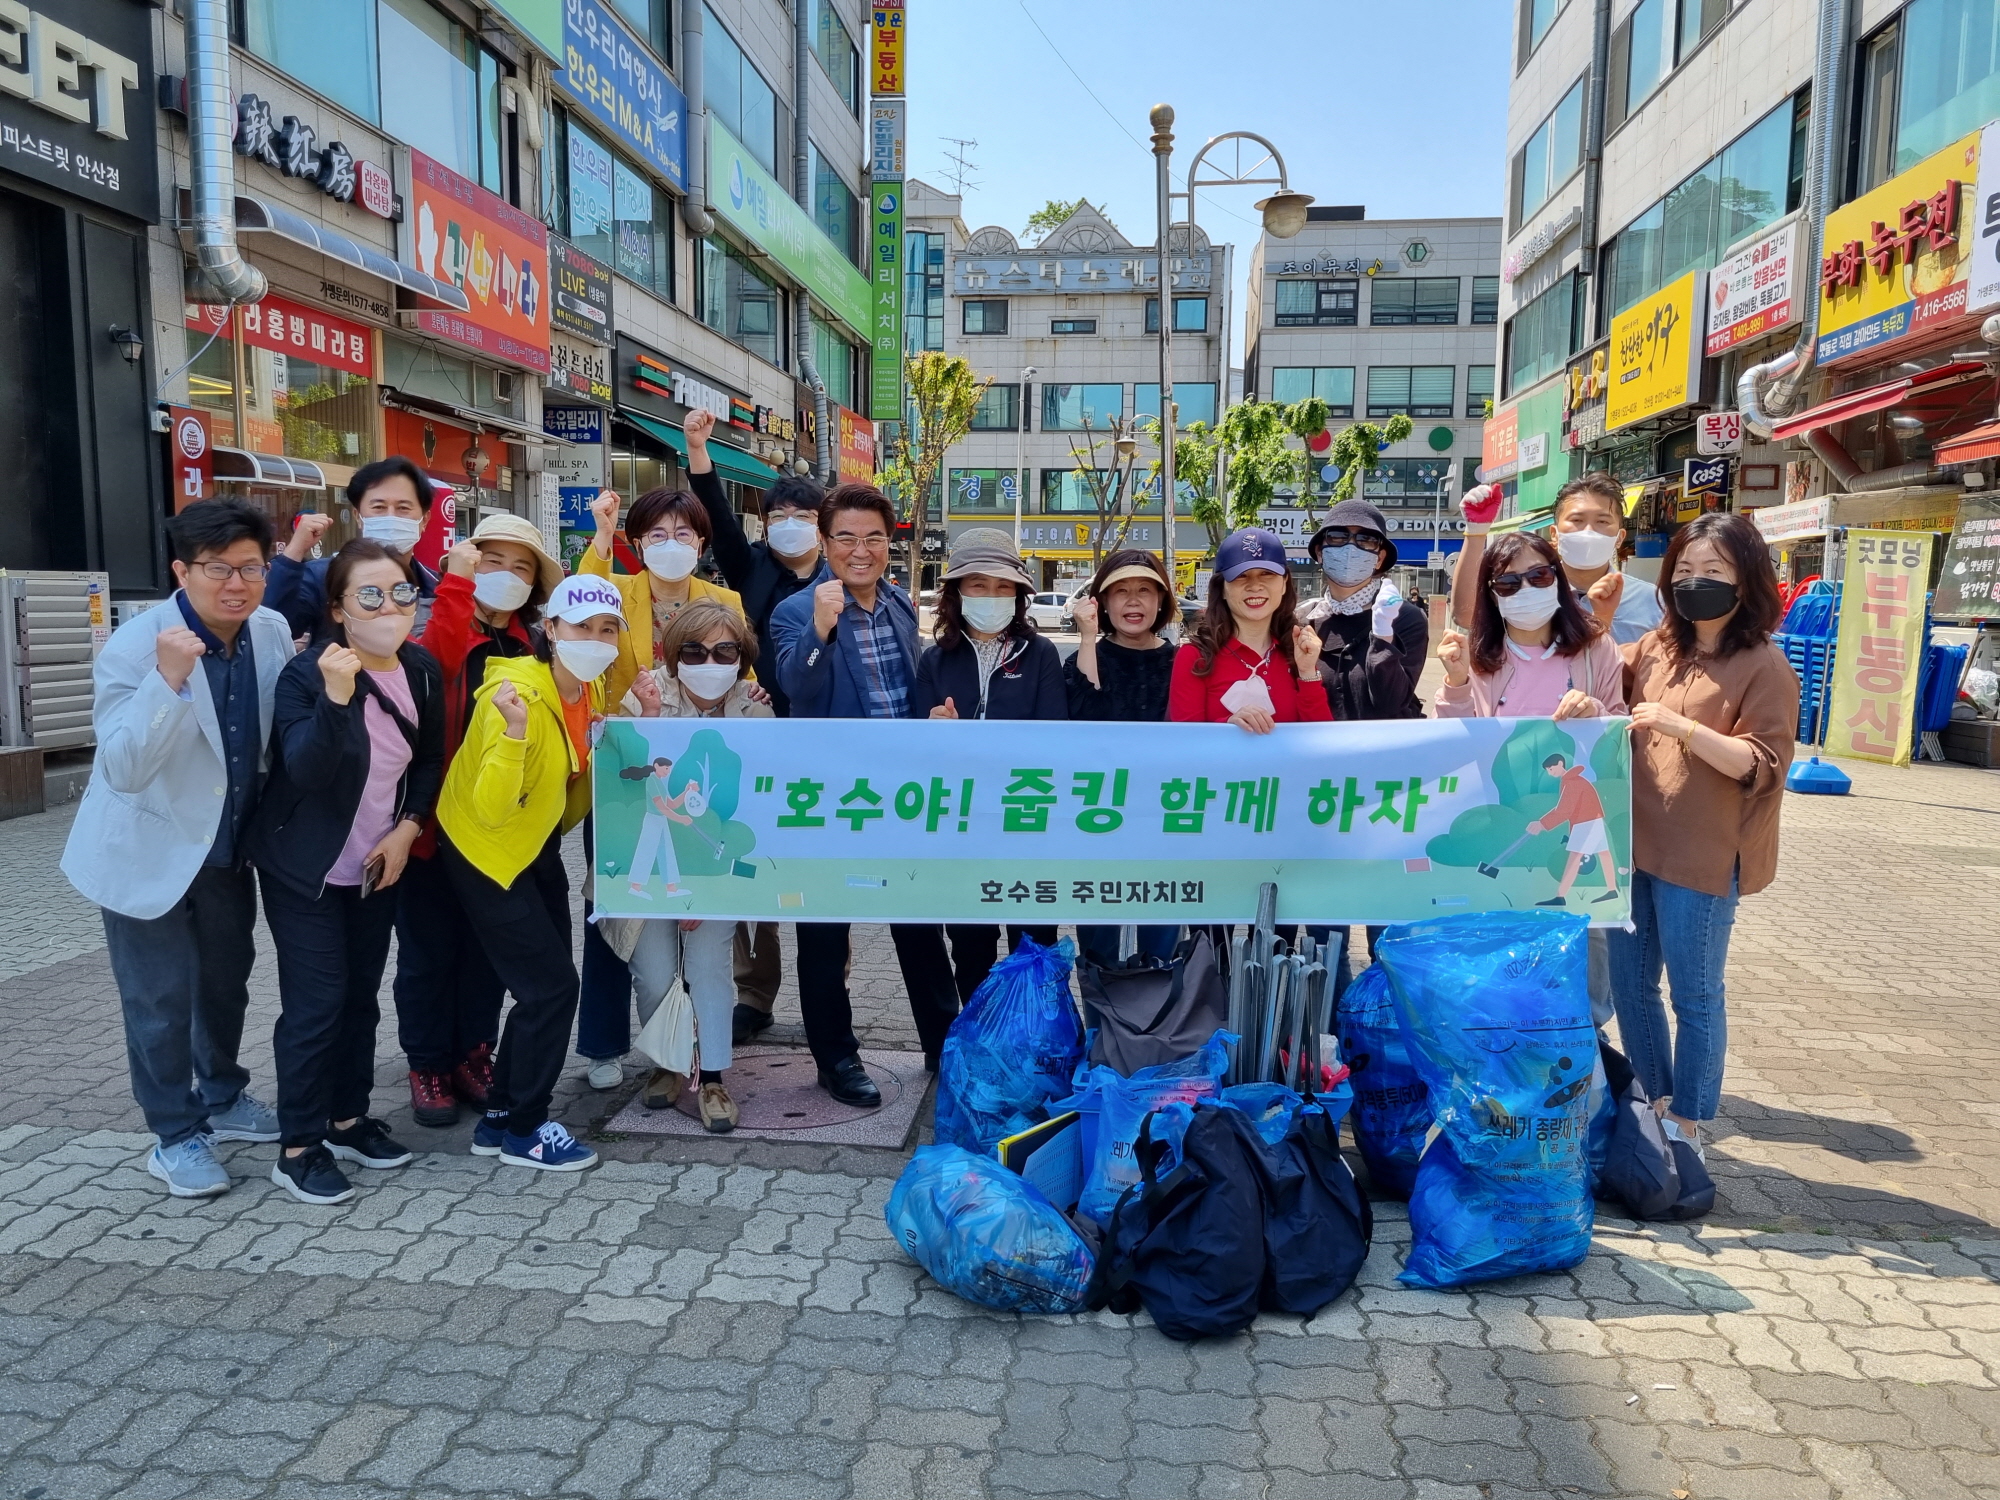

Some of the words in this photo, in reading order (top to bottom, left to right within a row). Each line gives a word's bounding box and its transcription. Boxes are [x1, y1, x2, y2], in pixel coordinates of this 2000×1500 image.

[878, 30, 898, 91] 부동산
[0, 123, 70, 172] 피스트릿
[76, 153, 121, 190] 안산점
[364, 168, 389, 195] 라홍방
[364, 187, 390, 213] 마라탕
[1866, 179, 1962, 277] 녹두전
[1279, 257, 1362, 278] 조이뮤직
[1818, 239, 1866, 299] 부화
[560, 267, 586, 298] LIVE
[244, 303, 365, 365] 라홍방마라탕
[1839, 331, 1852, 350] 직접
[1882, 312, 1905, 335] 녹두전
[555, 409, 600, 431] 유빌리지
[1704, 413, 1741, 440] 복싱
[548, 459, 568, 469] HILL
[571, 459, 590, 469] SPA
[184, 466, 204, 498] 라
[1019, 528, 1073, 540] MEGA
[1263, 518, 1295, 536] 명인
[1858, 538, 1922, 568] 굿모닝
[1960, 581, 1990, 600] 닭강정
[1844, 572, 1910, 756] 부동산
[753, 774, 976, 834] "호수야!
[1000, 767, 1129, 835] 줍킹
[1159, 776, 1281, 835] 함께
[1307, 776, 1459, 834] 하자"
[979, 879, 1059, 904] 호수동
[1071, 879, 1205, 904] 주민자치회
[1487, 1114, 1532, 1141] 쓰레기
[1536, 1117, 1573, 1142] 종량제
[1110, 1140, 1135, 1160] 레기
